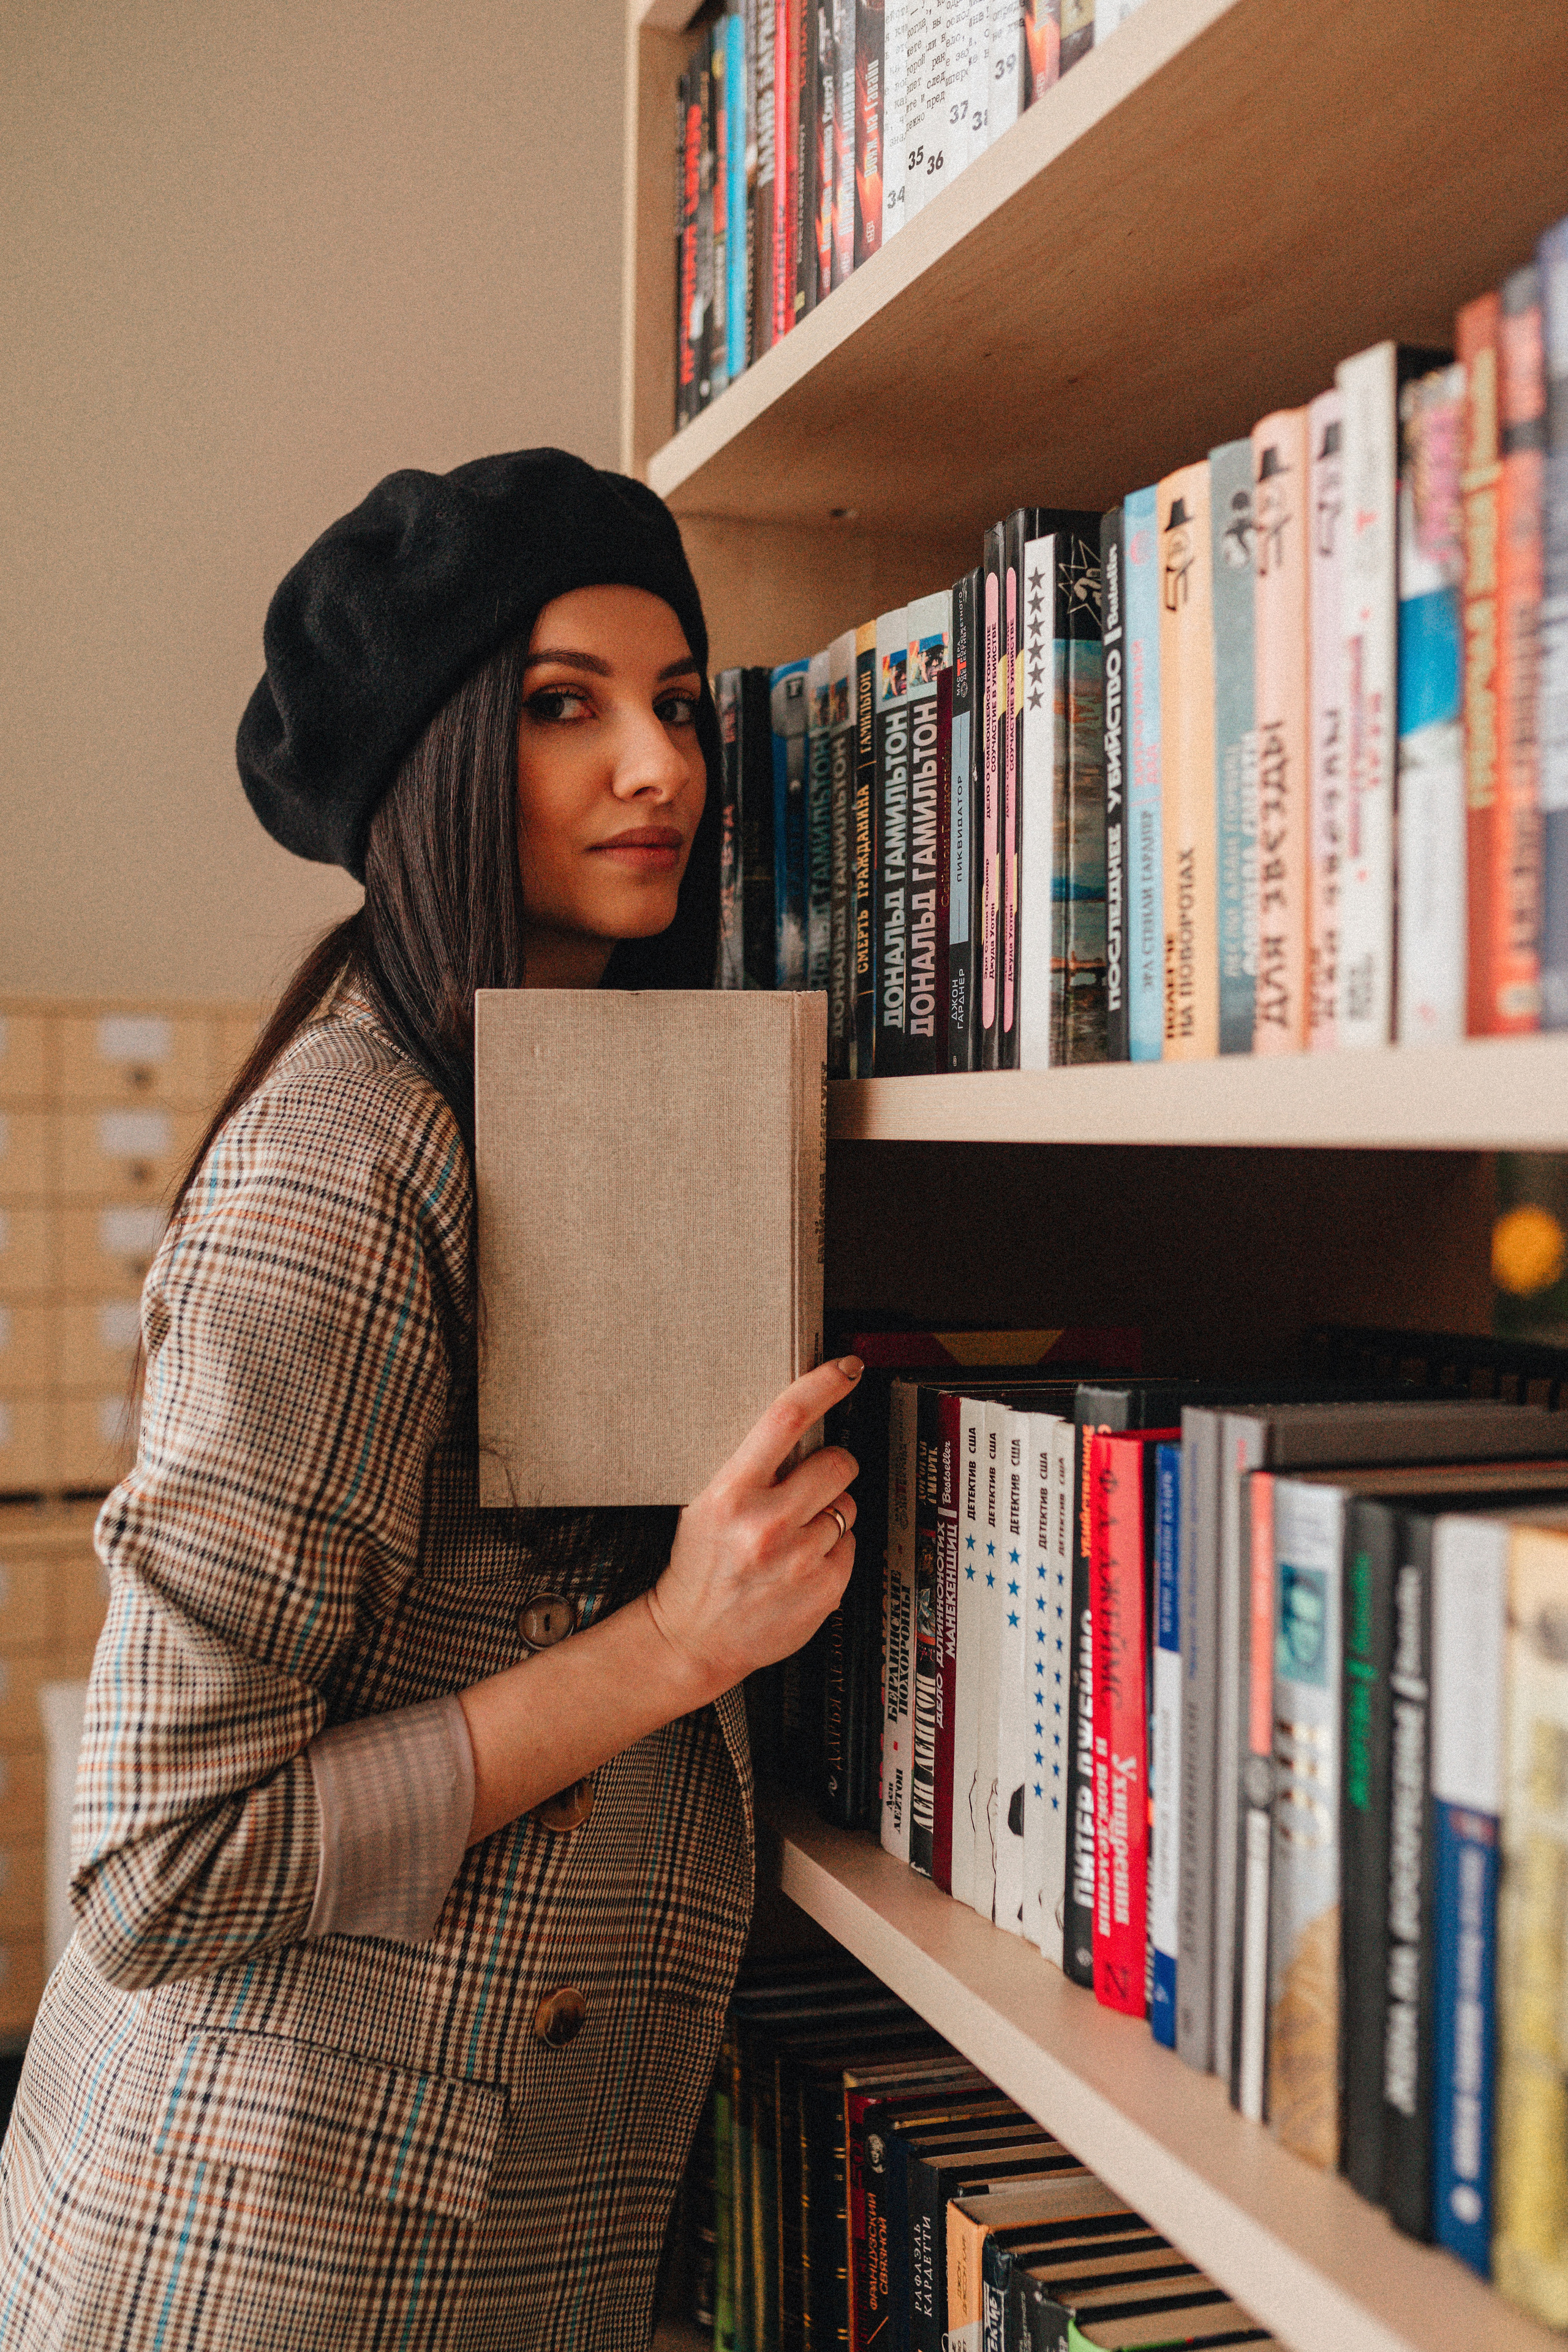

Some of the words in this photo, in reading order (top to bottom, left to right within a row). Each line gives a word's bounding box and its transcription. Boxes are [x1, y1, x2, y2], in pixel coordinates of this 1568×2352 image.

[864, 59, 879, 111] Гавайи
[995, 53, 1016, 80] 39
[867, 114, 878, 134] на
[950, 100, 968, 124] 37
[864, 137, 878, 178] Вояж
[908, 145, 924, 170] 35
[927, 150, 944, 175] 36
[888, 186, 905, 209] 34
[858, 670, 873, 753] ГАМИЛЬТОН
[1106, 649, 1122, 814] УБИЙСТВО
[884, 709, 908, 881] ГАМИЛЬТОН
[911, 699, 937, 882] ГАМИЛЬТОН
[856, 784, 870, 897] ГРАЖДАНИНА
[856, 910, 869, 974] СМЕРТЬ
[1107, 823, 1122, 1011] ПОСЛЕДНЕЕ
[1178, 848, 1195, 997] ПОВОРОТАХ
[883, 888, 906, 1028] ДОНАЛЬД
[910, 888, 935, 1038] ДОНАЛЬД
[957, 968, 966, 1030] ГАРДНЕР
[927, 1447, 938, 1504] СМЕРТЬ
[942, 1441, 951, 1504] Bestseller
[967, 1460, 976, 1521] ДЕТЕКТИВ
[1011, 1439, 1020, 1466] США
[1039, 1452, 1048, 1480] США
[1010, 1474, 1020, 1535] ДЕТЕКТИВ
[1038, 1487, 1047, 1550] ДЕТЕКТИВ
[936, 1521, 945, 1668] ДЛИННОНОГИХ
[945, 1523, 958, 1659] МАНЕКЕНЩИЦ
[888, 1569, 901, 1724] БЕРЛИНСКИЕ
[899, 1585, 911, 1716] ПОХОРОНЫ
[1074, 1784, 1095, 1909] ПИТЕР
[1109, 1752, 1138, 1926] Ухищрения
[866, 2192, 878, 2311] ФРАНЦУЗСКИЙ
[876, 2216, 889, 2295] СВЯЗНОЙ
[913, 2223, 922, 2312] РАФАЭЛЬ
[922, 2215, 933, 2318] КАРДЕТТИ
[989, 2296, 1001, 2352] ЕКТИВ
